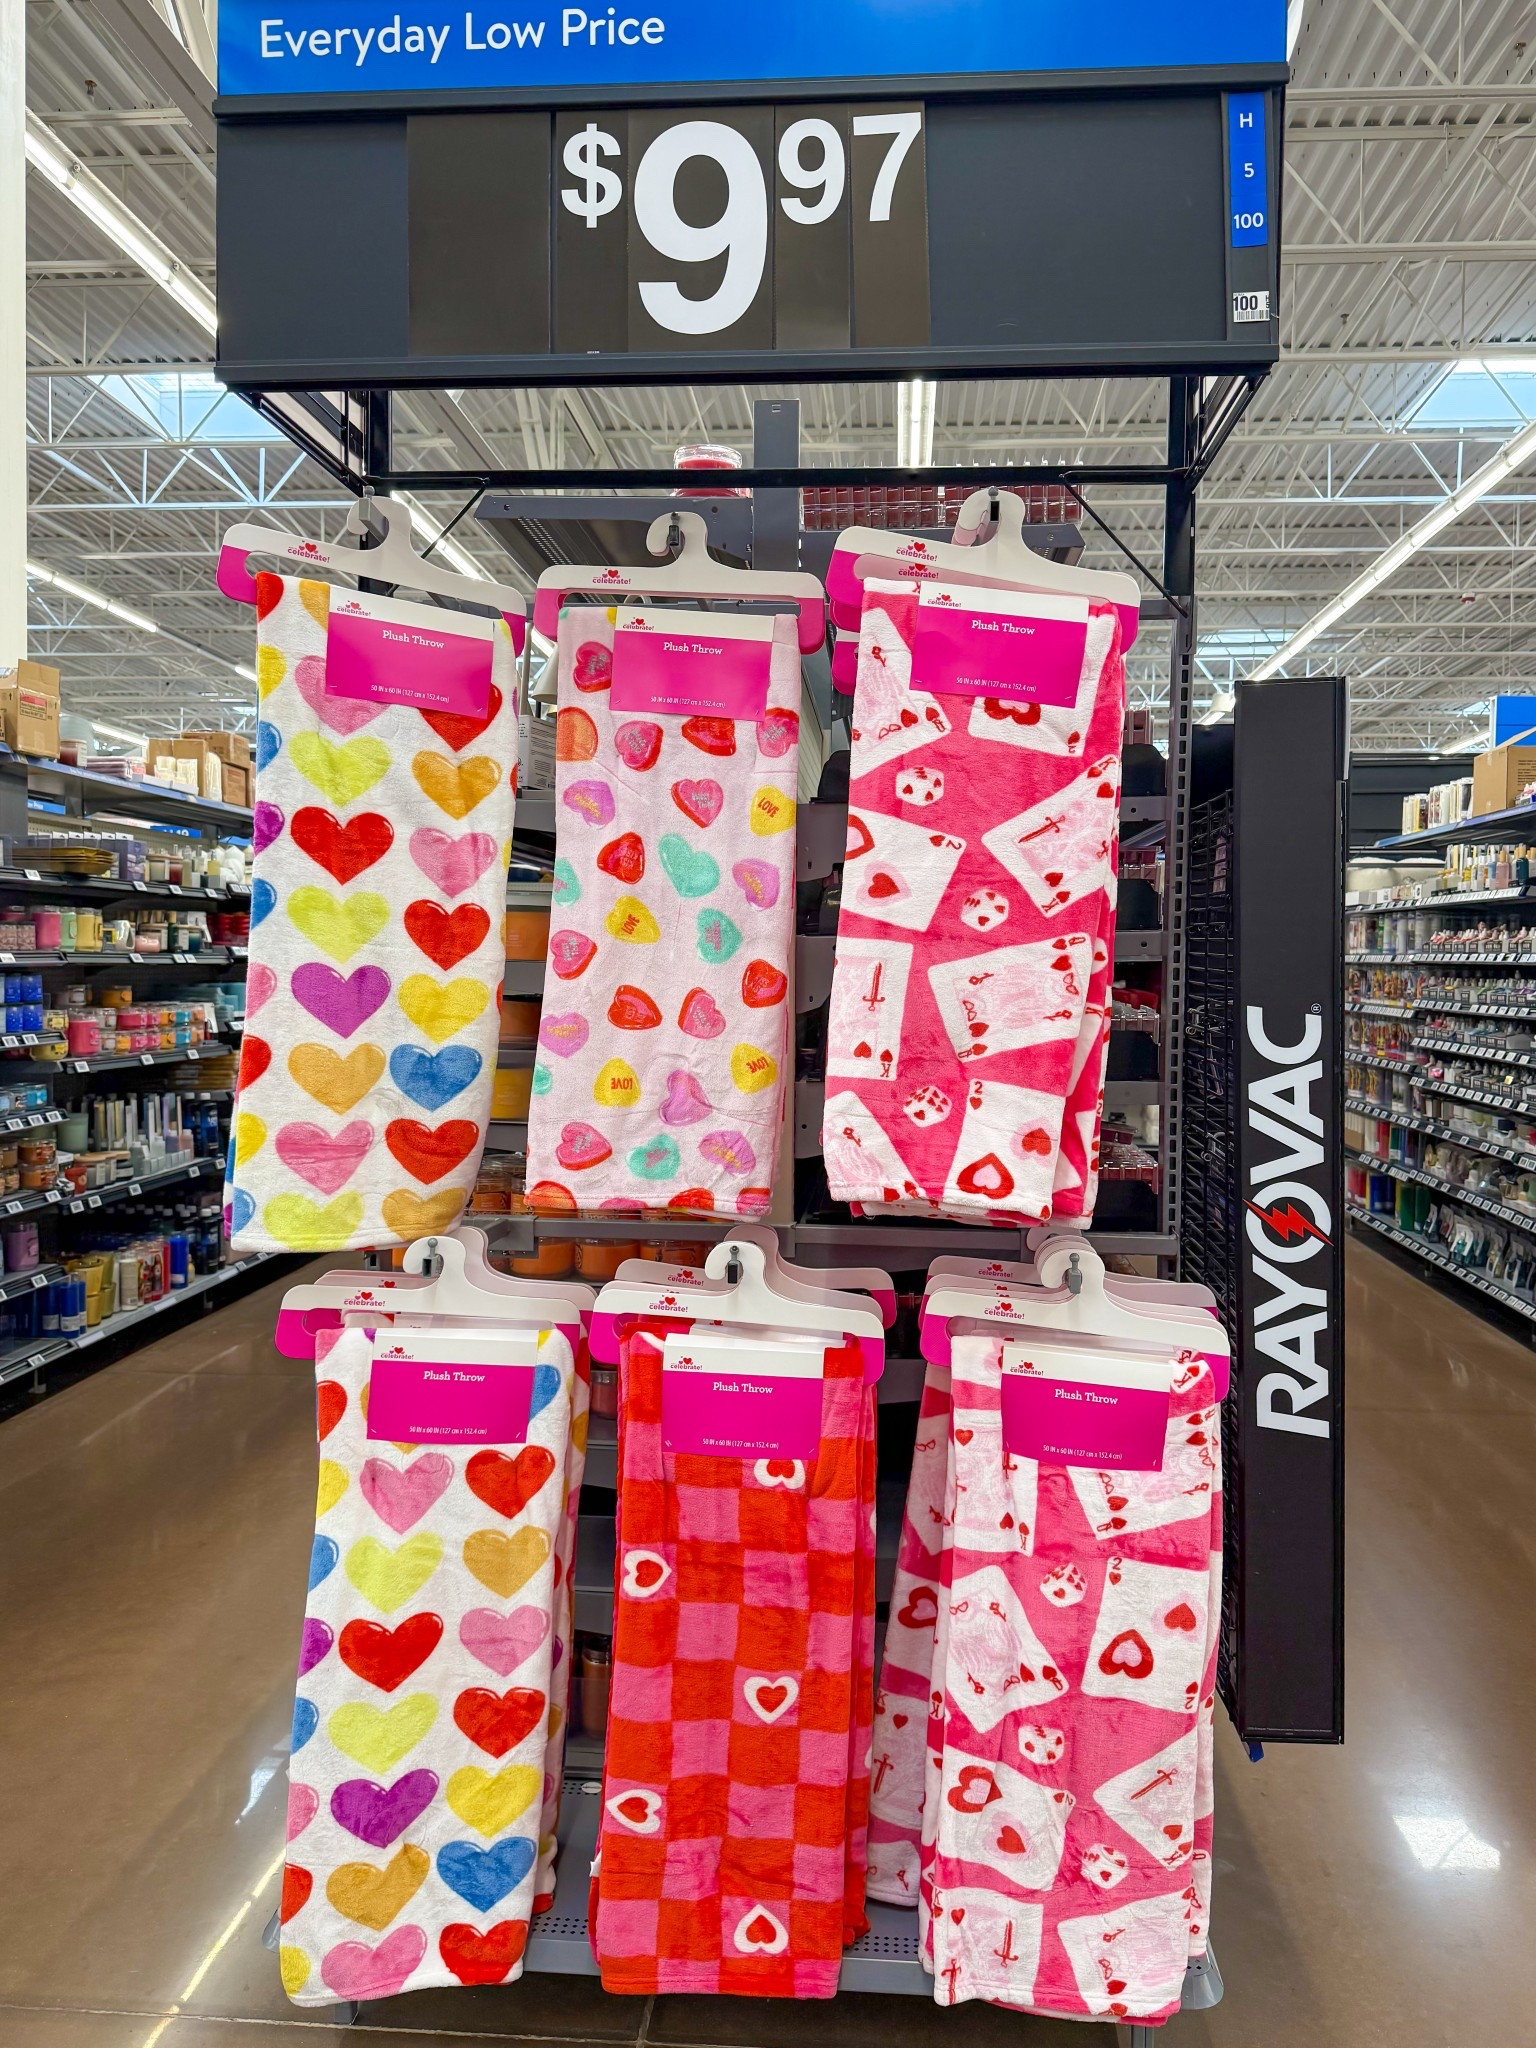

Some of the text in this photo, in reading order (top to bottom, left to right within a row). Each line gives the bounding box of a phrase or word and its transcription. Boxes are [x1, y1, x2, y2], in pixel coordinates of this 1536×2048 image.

[261, 8, 666, 66] Everyday Low Price
[1239, 113, 1253, 128] H
[1244, 163, 1255, 178] 5
[1234, 212, 1264, 229] 100
[1233, 295, 1258, 311] 100
[972, 620, 1035, 635] Plush Throw
[383, 630, 444, 648] Plush Throw
[664, 642, 722, 654] Plush Throw
[758, 797, 779, 818] LOVE
[621, 913, 640, 935] LOVE
[746, 1056, 769, 1073] LOVE
[610, 1077, 633, 1090] LOVE
[974, 1081, 983, 1094] 2
[423, 1370, 485, 1382] Plush Throw
[713, 1382, 773, 1394] Plush Throw
[1054, 1388, 1118, 1405] Plush Throw
[1112, 1557, 1122, 1570] 2
[1185, 1697, 1195, 1709] 2
